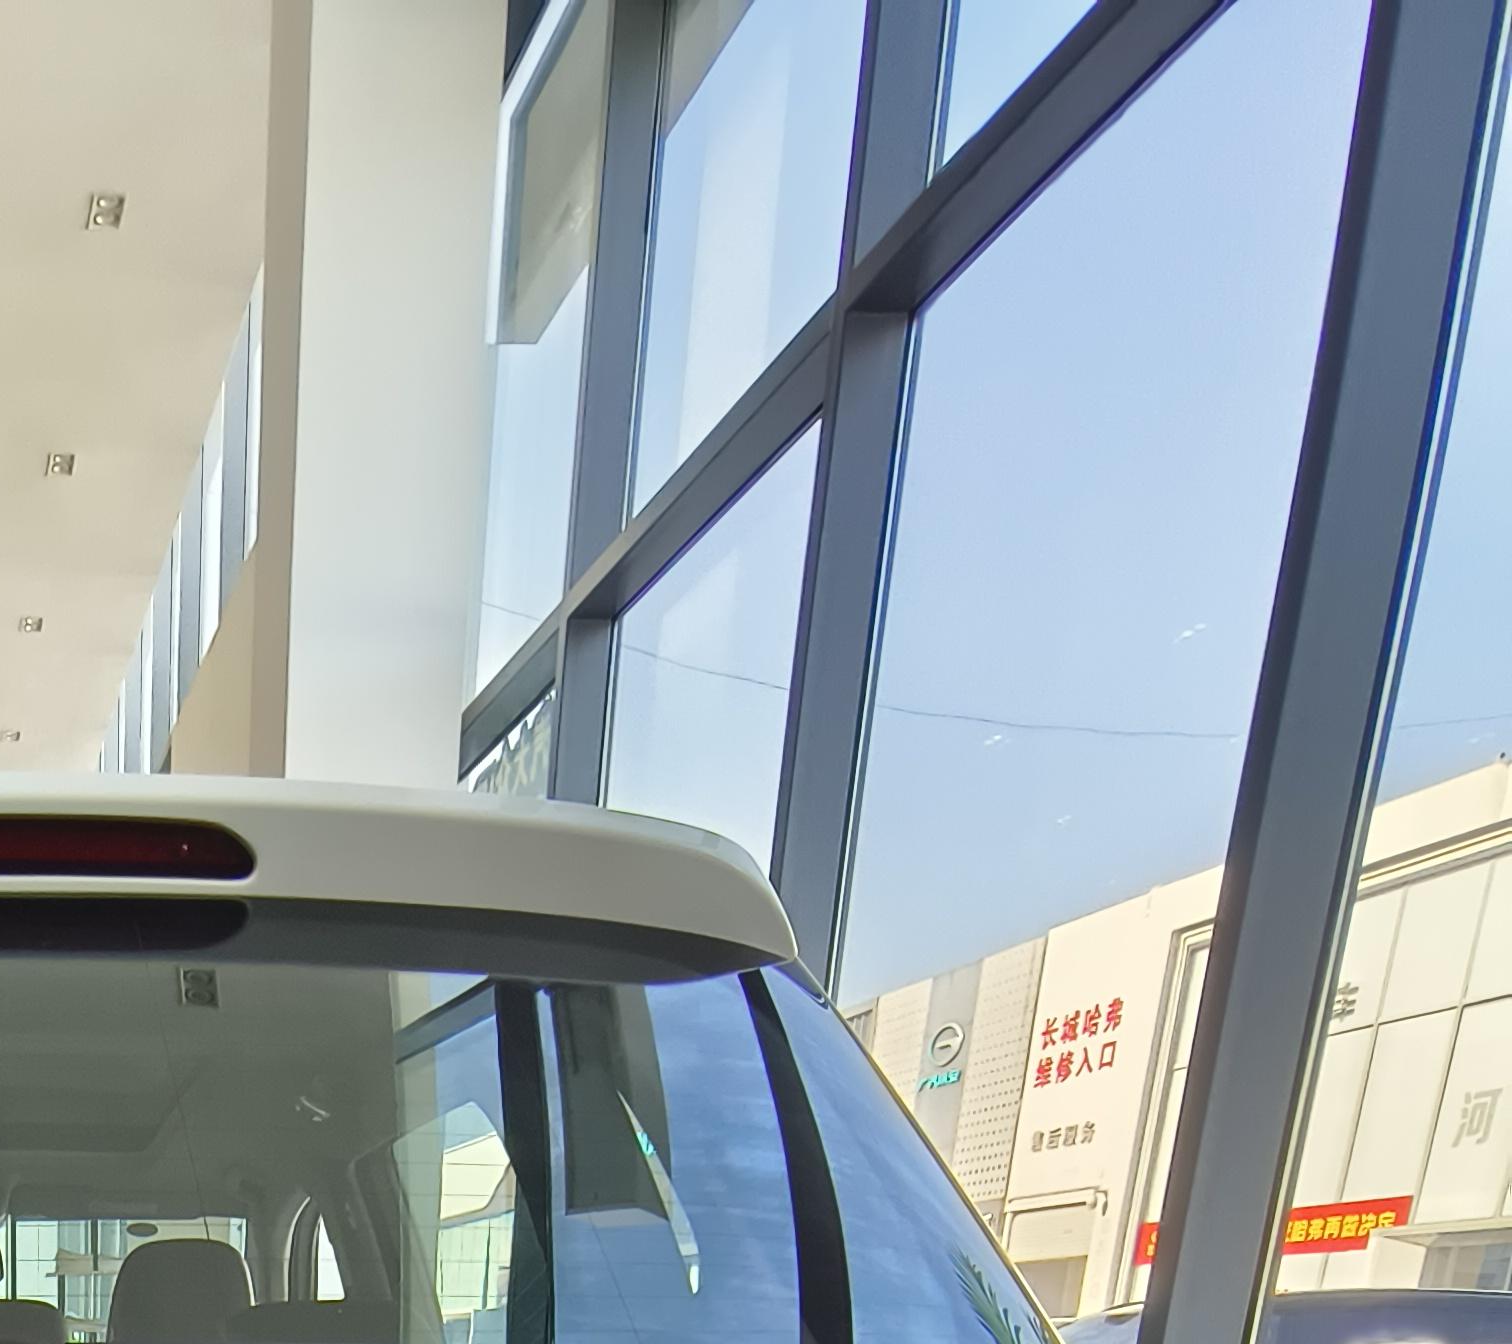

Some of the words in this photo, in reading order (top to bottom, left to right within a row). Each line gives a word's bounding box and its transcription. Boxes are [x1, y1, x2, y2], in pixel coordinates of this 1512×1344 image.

[1040, 997, 1124, 1050] 长城哈弗
[1033, 1040, 1117, 1088] 维修入口
[1451, 1087, 1503, 1148] 河
